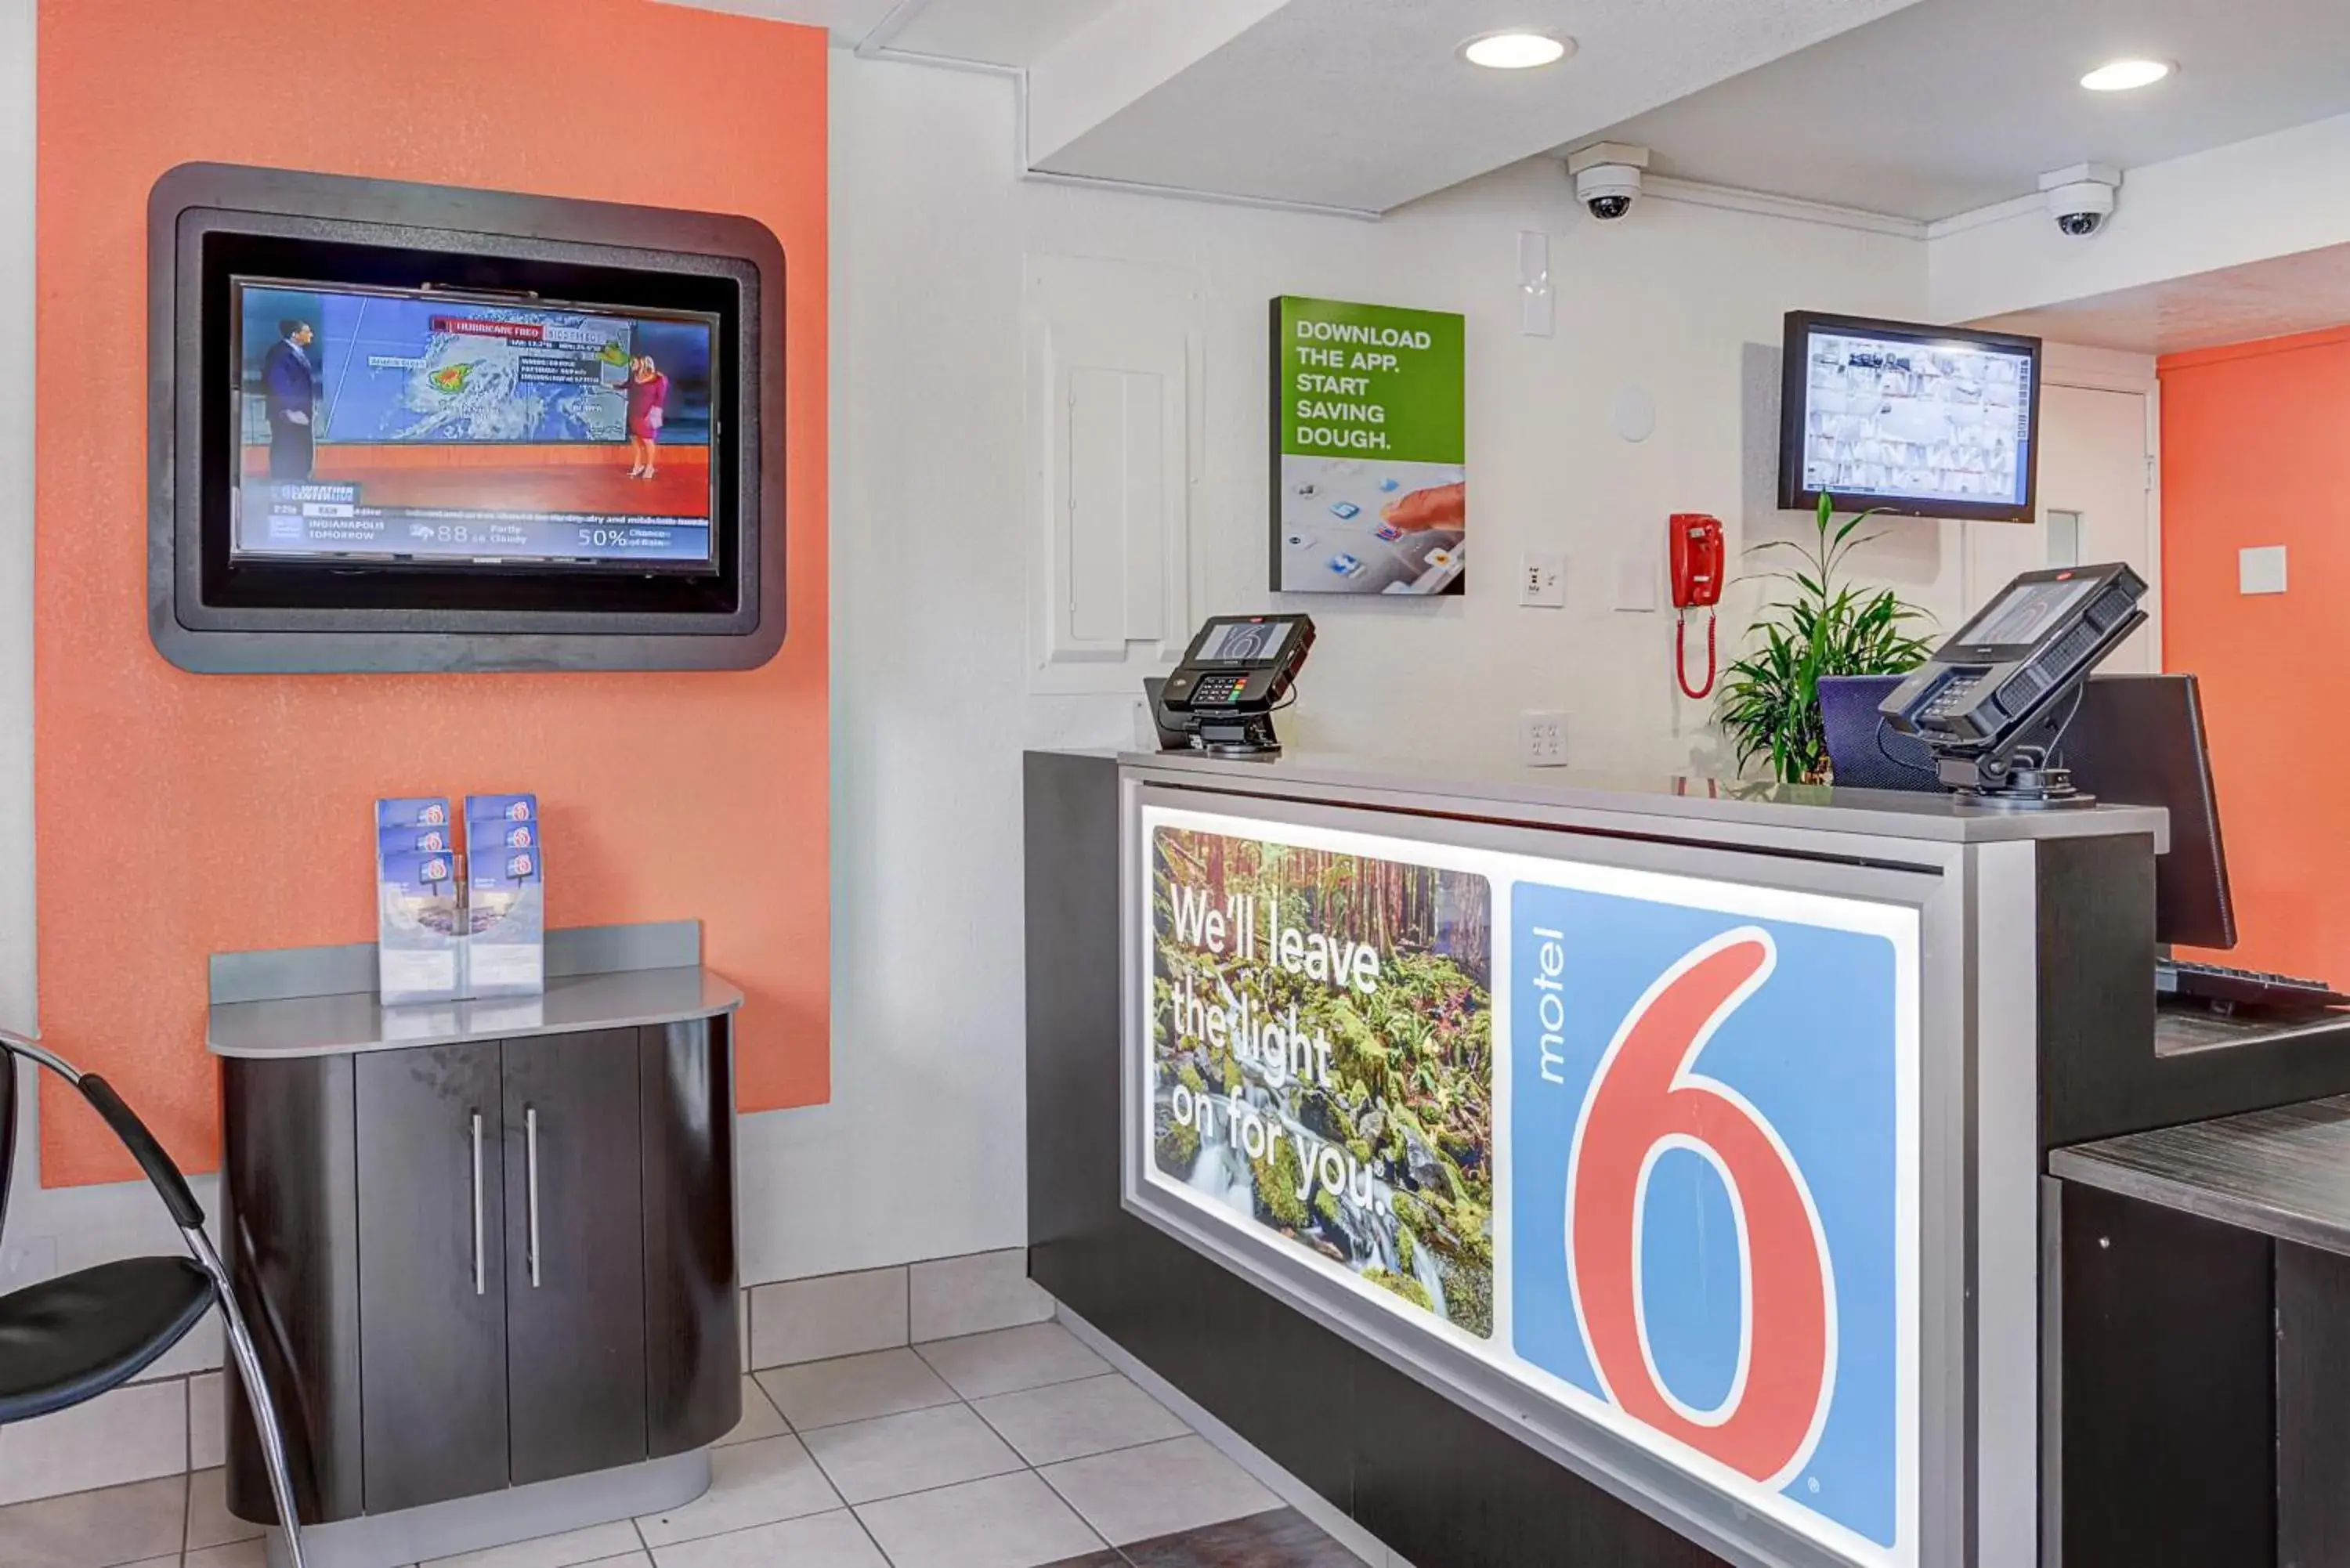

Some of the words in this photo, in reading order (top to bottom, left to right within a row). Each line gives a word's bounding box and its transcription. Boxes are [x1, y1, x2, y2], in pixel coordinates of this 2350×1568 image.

[1296, 320, 1431, 349] DOWNLOAD
[1296, 346, 1344, 369] THE
[1350, 352, 1401, 374] APP.
[1296, 373, 1370, 396] START
[1296, 399, 1385, 424] SAVING
[1296, 427, 1391, 450] DOUGH.
[309, 519, 385, 531] INDIANAPOLIS
[309, 530, 376, 540] TOMORROW
[438, 526, 468, 543] 88
[578, 529, 627, 547] 50%
[1170, 882, 1254, 961] We'll
[1269, 901, 1380, 994] leave
[1532, 927, 1565, 1085] motel
[1173, 980, 1227, 1048] the
[1241, 992, 1332, 1089] light
[1172, 1084, 1213, 1137] on
[1226, 1086, 1283, 1165] for
[1295, 1135, 1386, 1217] you.
[1565, 924, 1839, 1494] 6
